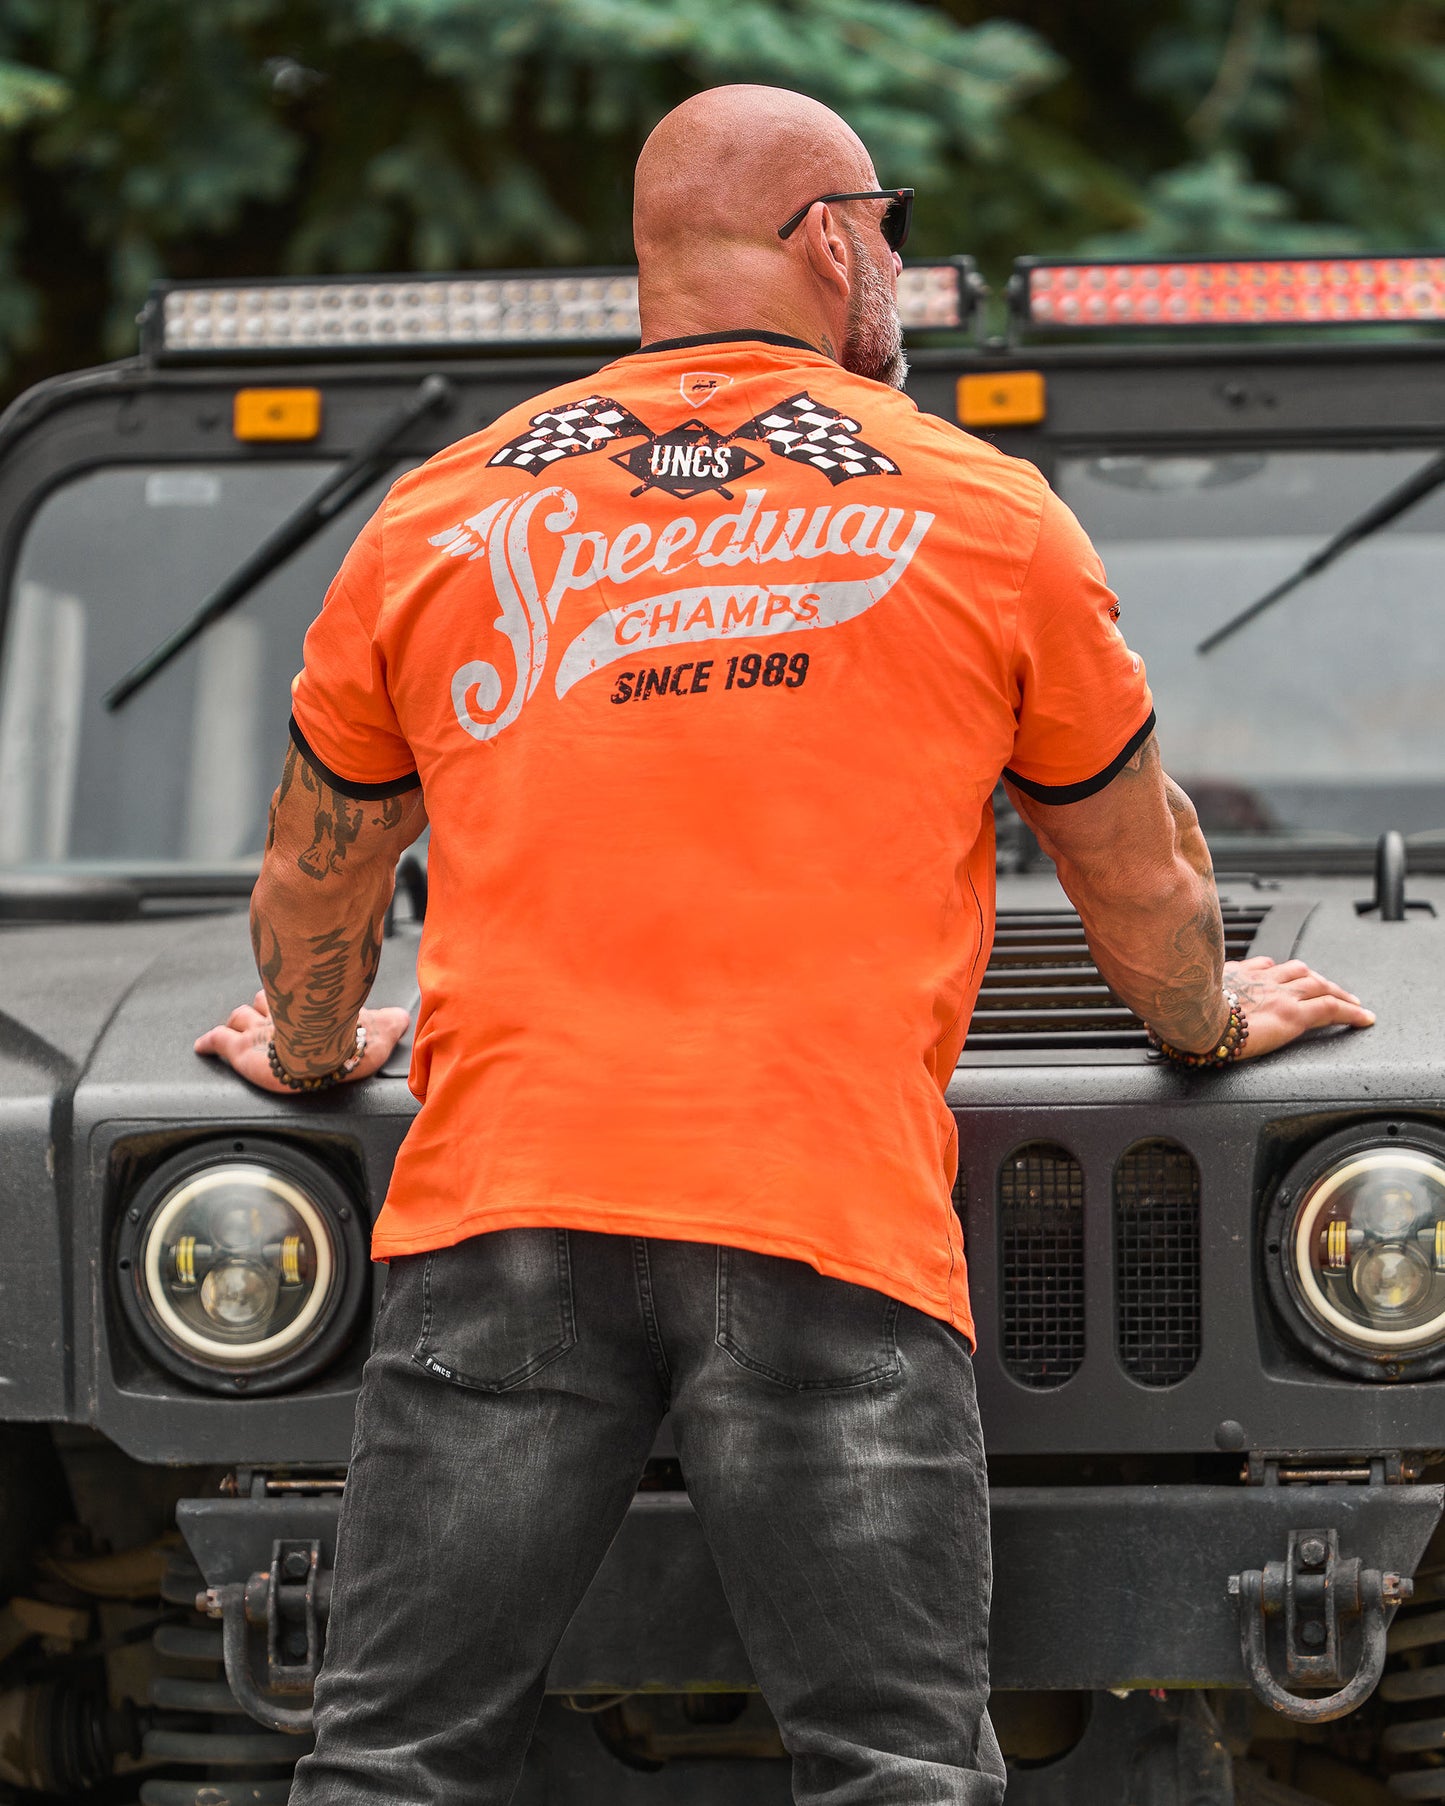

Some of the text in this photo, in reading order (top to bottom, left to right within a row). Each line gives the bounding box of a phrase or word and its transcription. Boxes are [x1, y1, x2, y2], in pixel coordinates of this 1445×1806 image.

[651, 444, 732, 479] UNCS
[427, 486, 935, 742] Speedway
[614, 593, 821, 646] CHAMPS
[610, 652, 810, 705] SINCE 1989
[432, 1362, 452, 1378] UNCS
